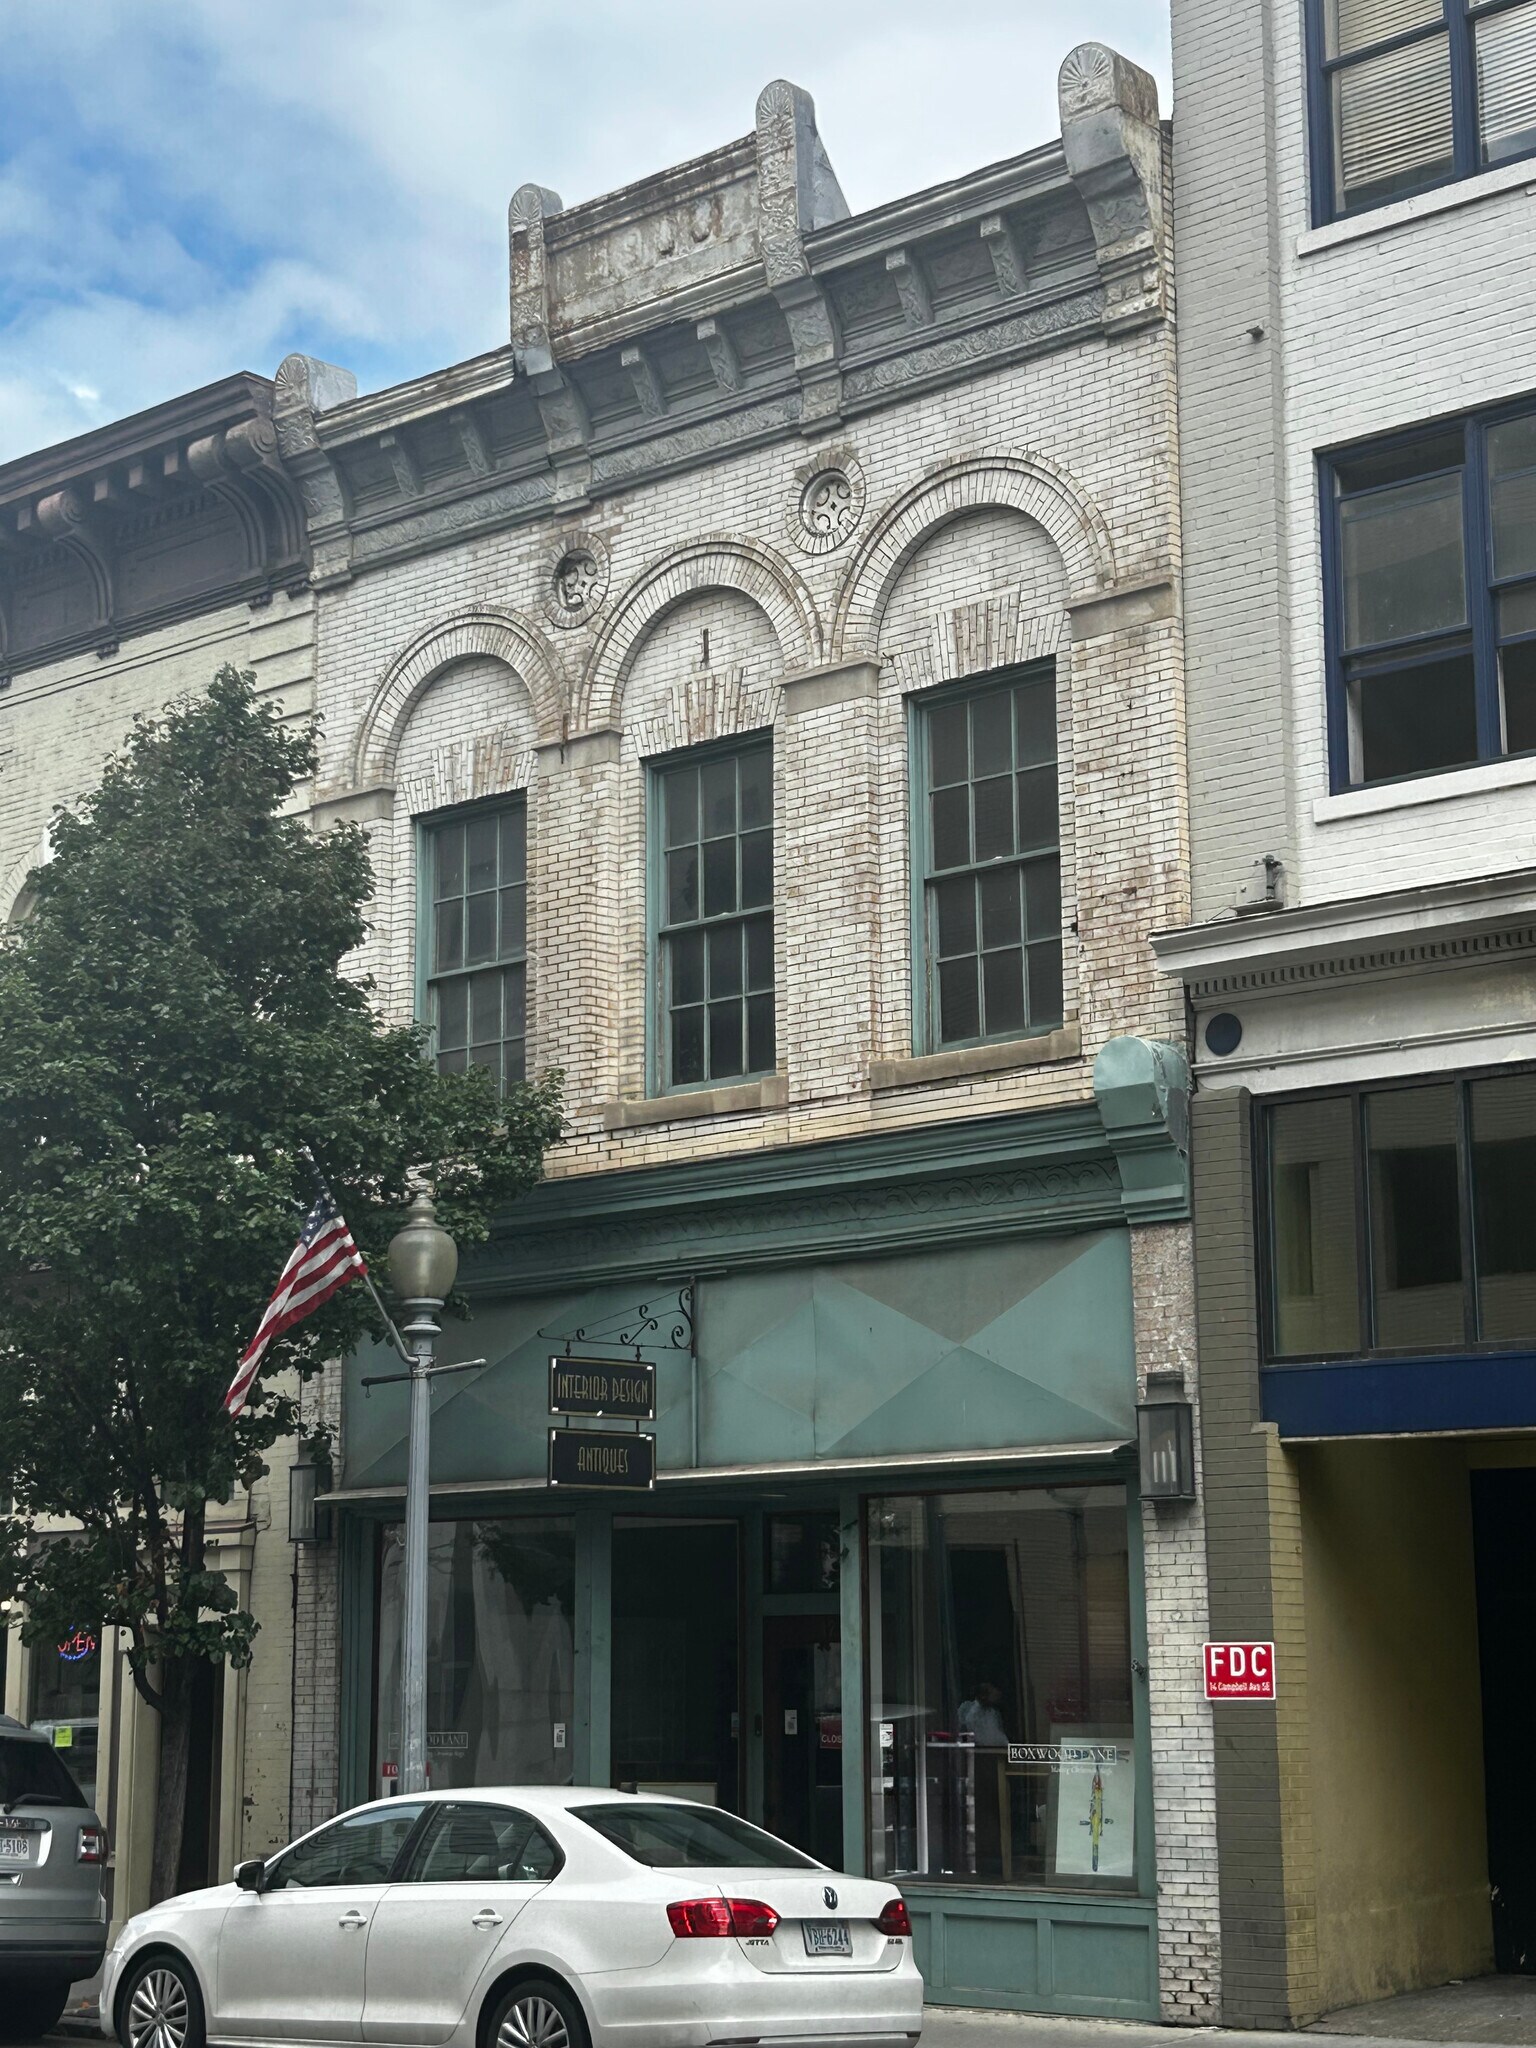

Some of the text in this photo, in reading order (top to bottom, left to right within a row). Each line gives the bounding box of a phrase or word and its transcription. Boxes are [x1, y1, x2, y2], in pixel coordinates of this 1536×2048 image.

[557, 1373, 648, 1404] INTERIOR DESIGN
[577, 1446, 628, 1475] ANTIQUES
[1210, 1646, 1267, 1677] FDC
[821, 1734, 842, 1744] CLOS
